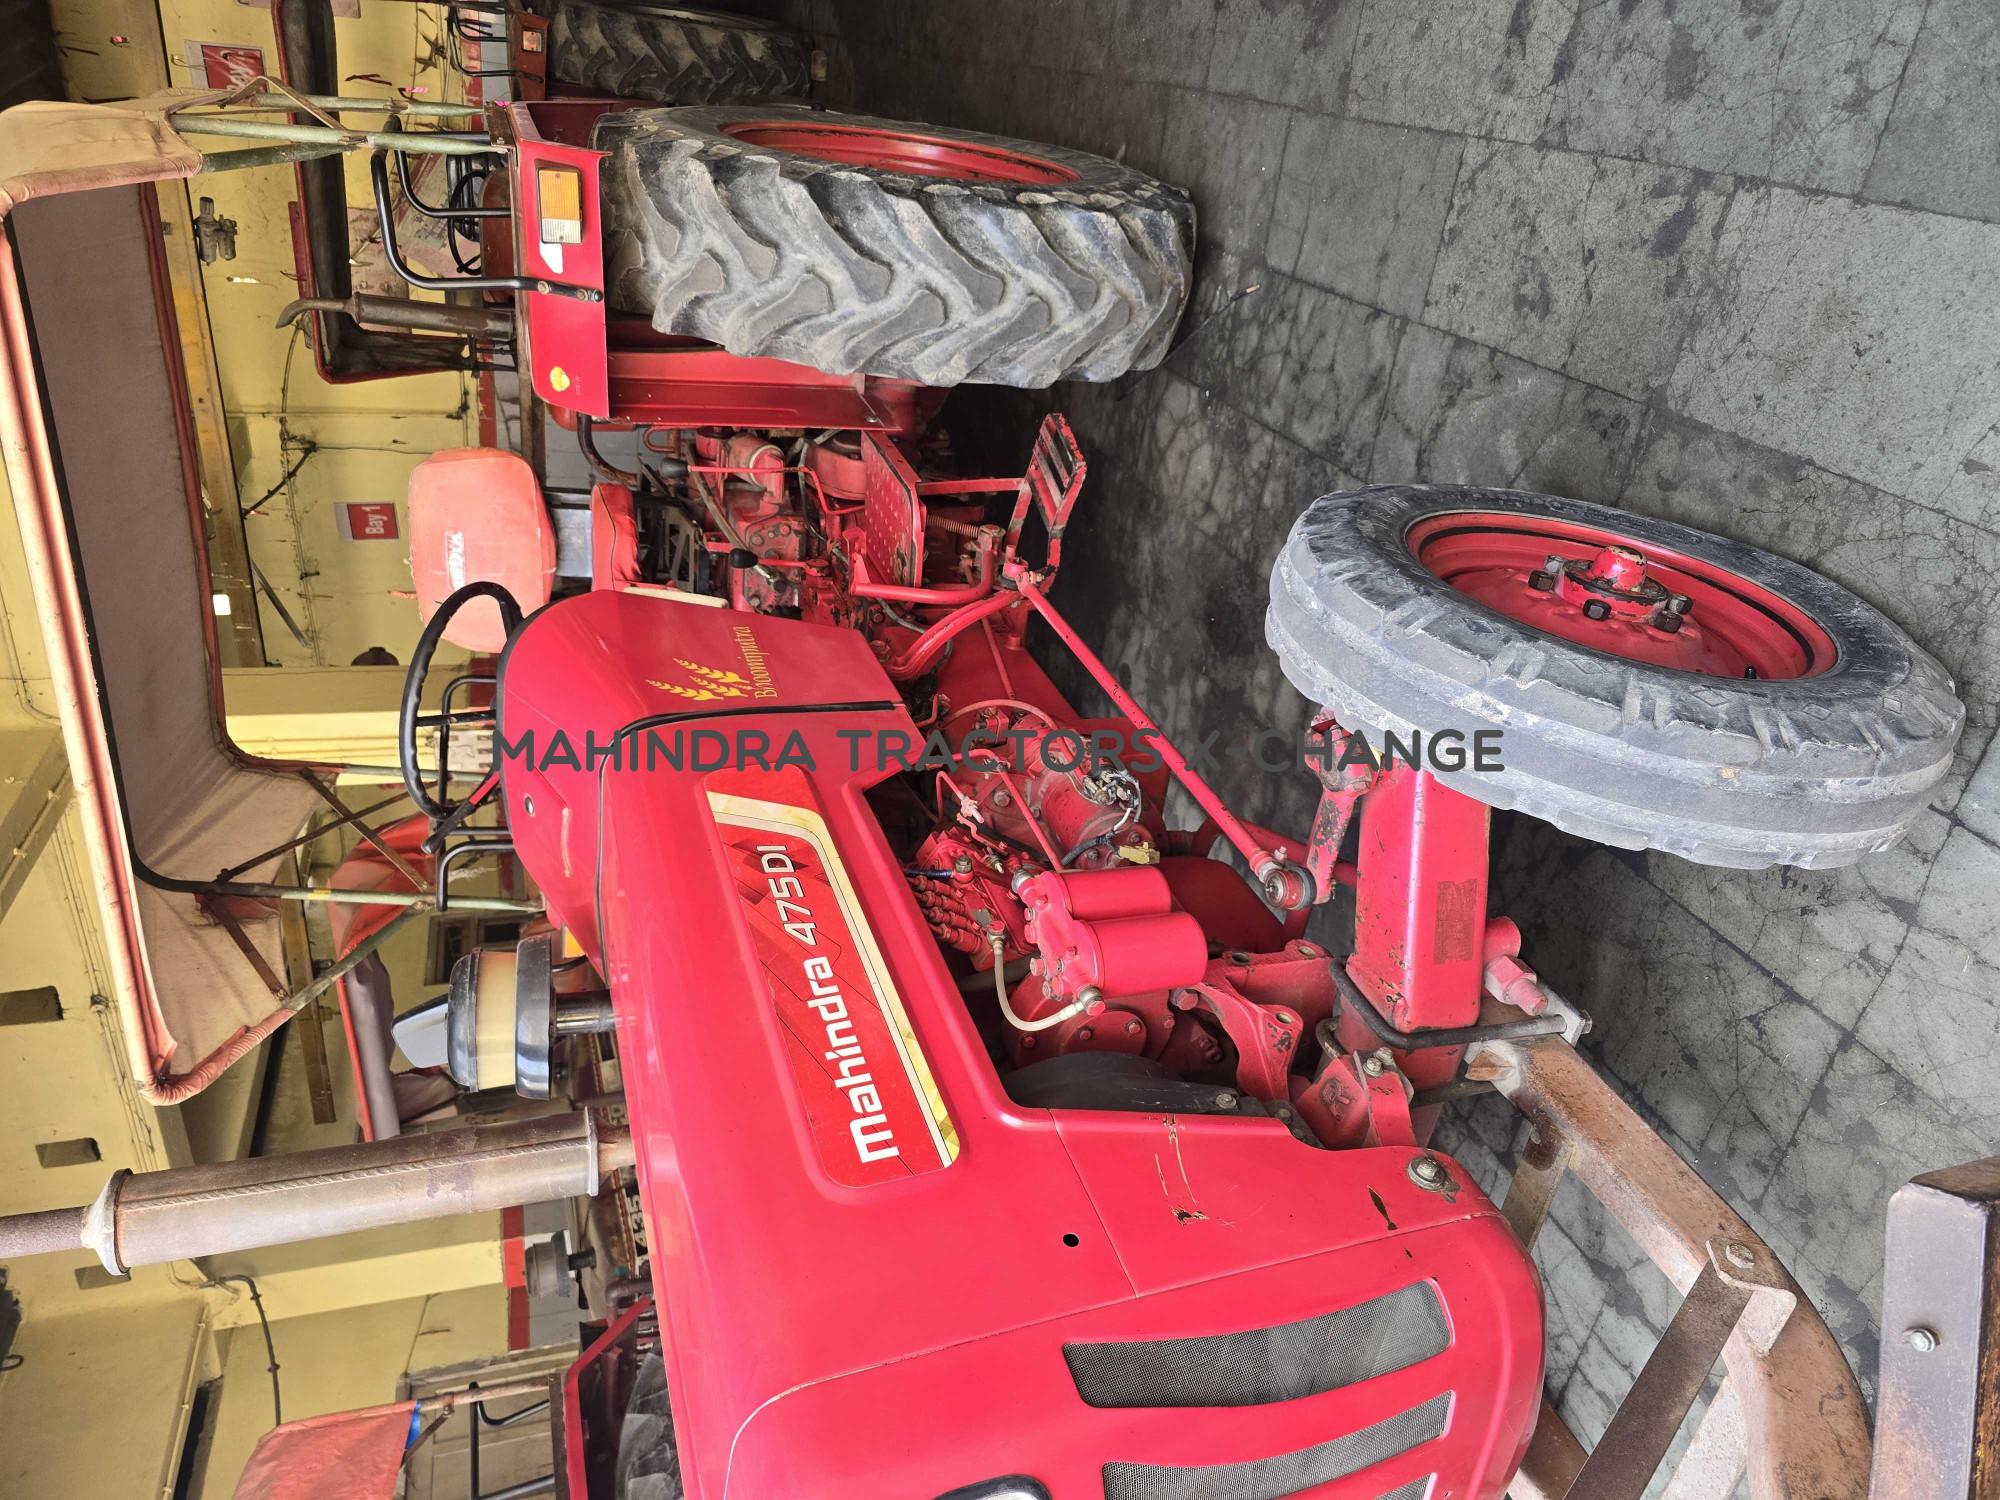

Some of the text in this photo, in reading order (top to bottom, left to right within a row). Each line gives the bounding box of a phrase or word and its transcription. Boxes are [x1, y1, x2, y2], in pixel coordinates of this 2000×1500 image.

[366, 514, 387, 534] Bay
[732, 626, 778, 699] Bhoomiputra
[803, 956, 900, 1164] Mahindra
[627, 1195, 648, 1247] 435
